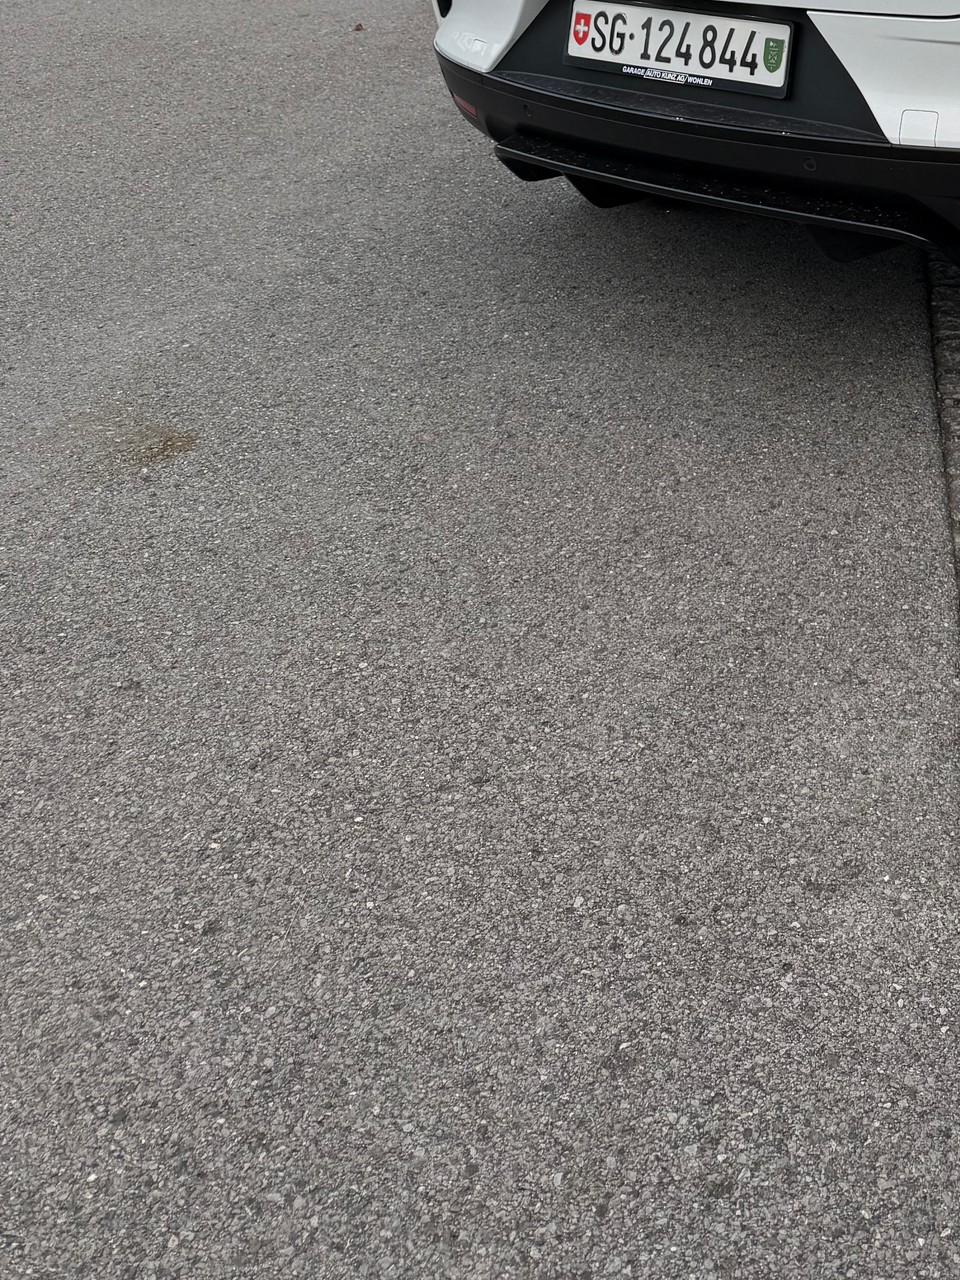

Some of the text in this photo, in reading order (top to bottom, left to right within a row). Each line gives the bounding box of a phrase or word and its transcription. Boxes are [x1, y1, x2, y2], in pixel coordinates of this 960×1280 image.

[622, 66, 645, 76] GARAGE
[646, 69, 661, 78] AUTO
[687, 76, 713, 86] WOHLEN
